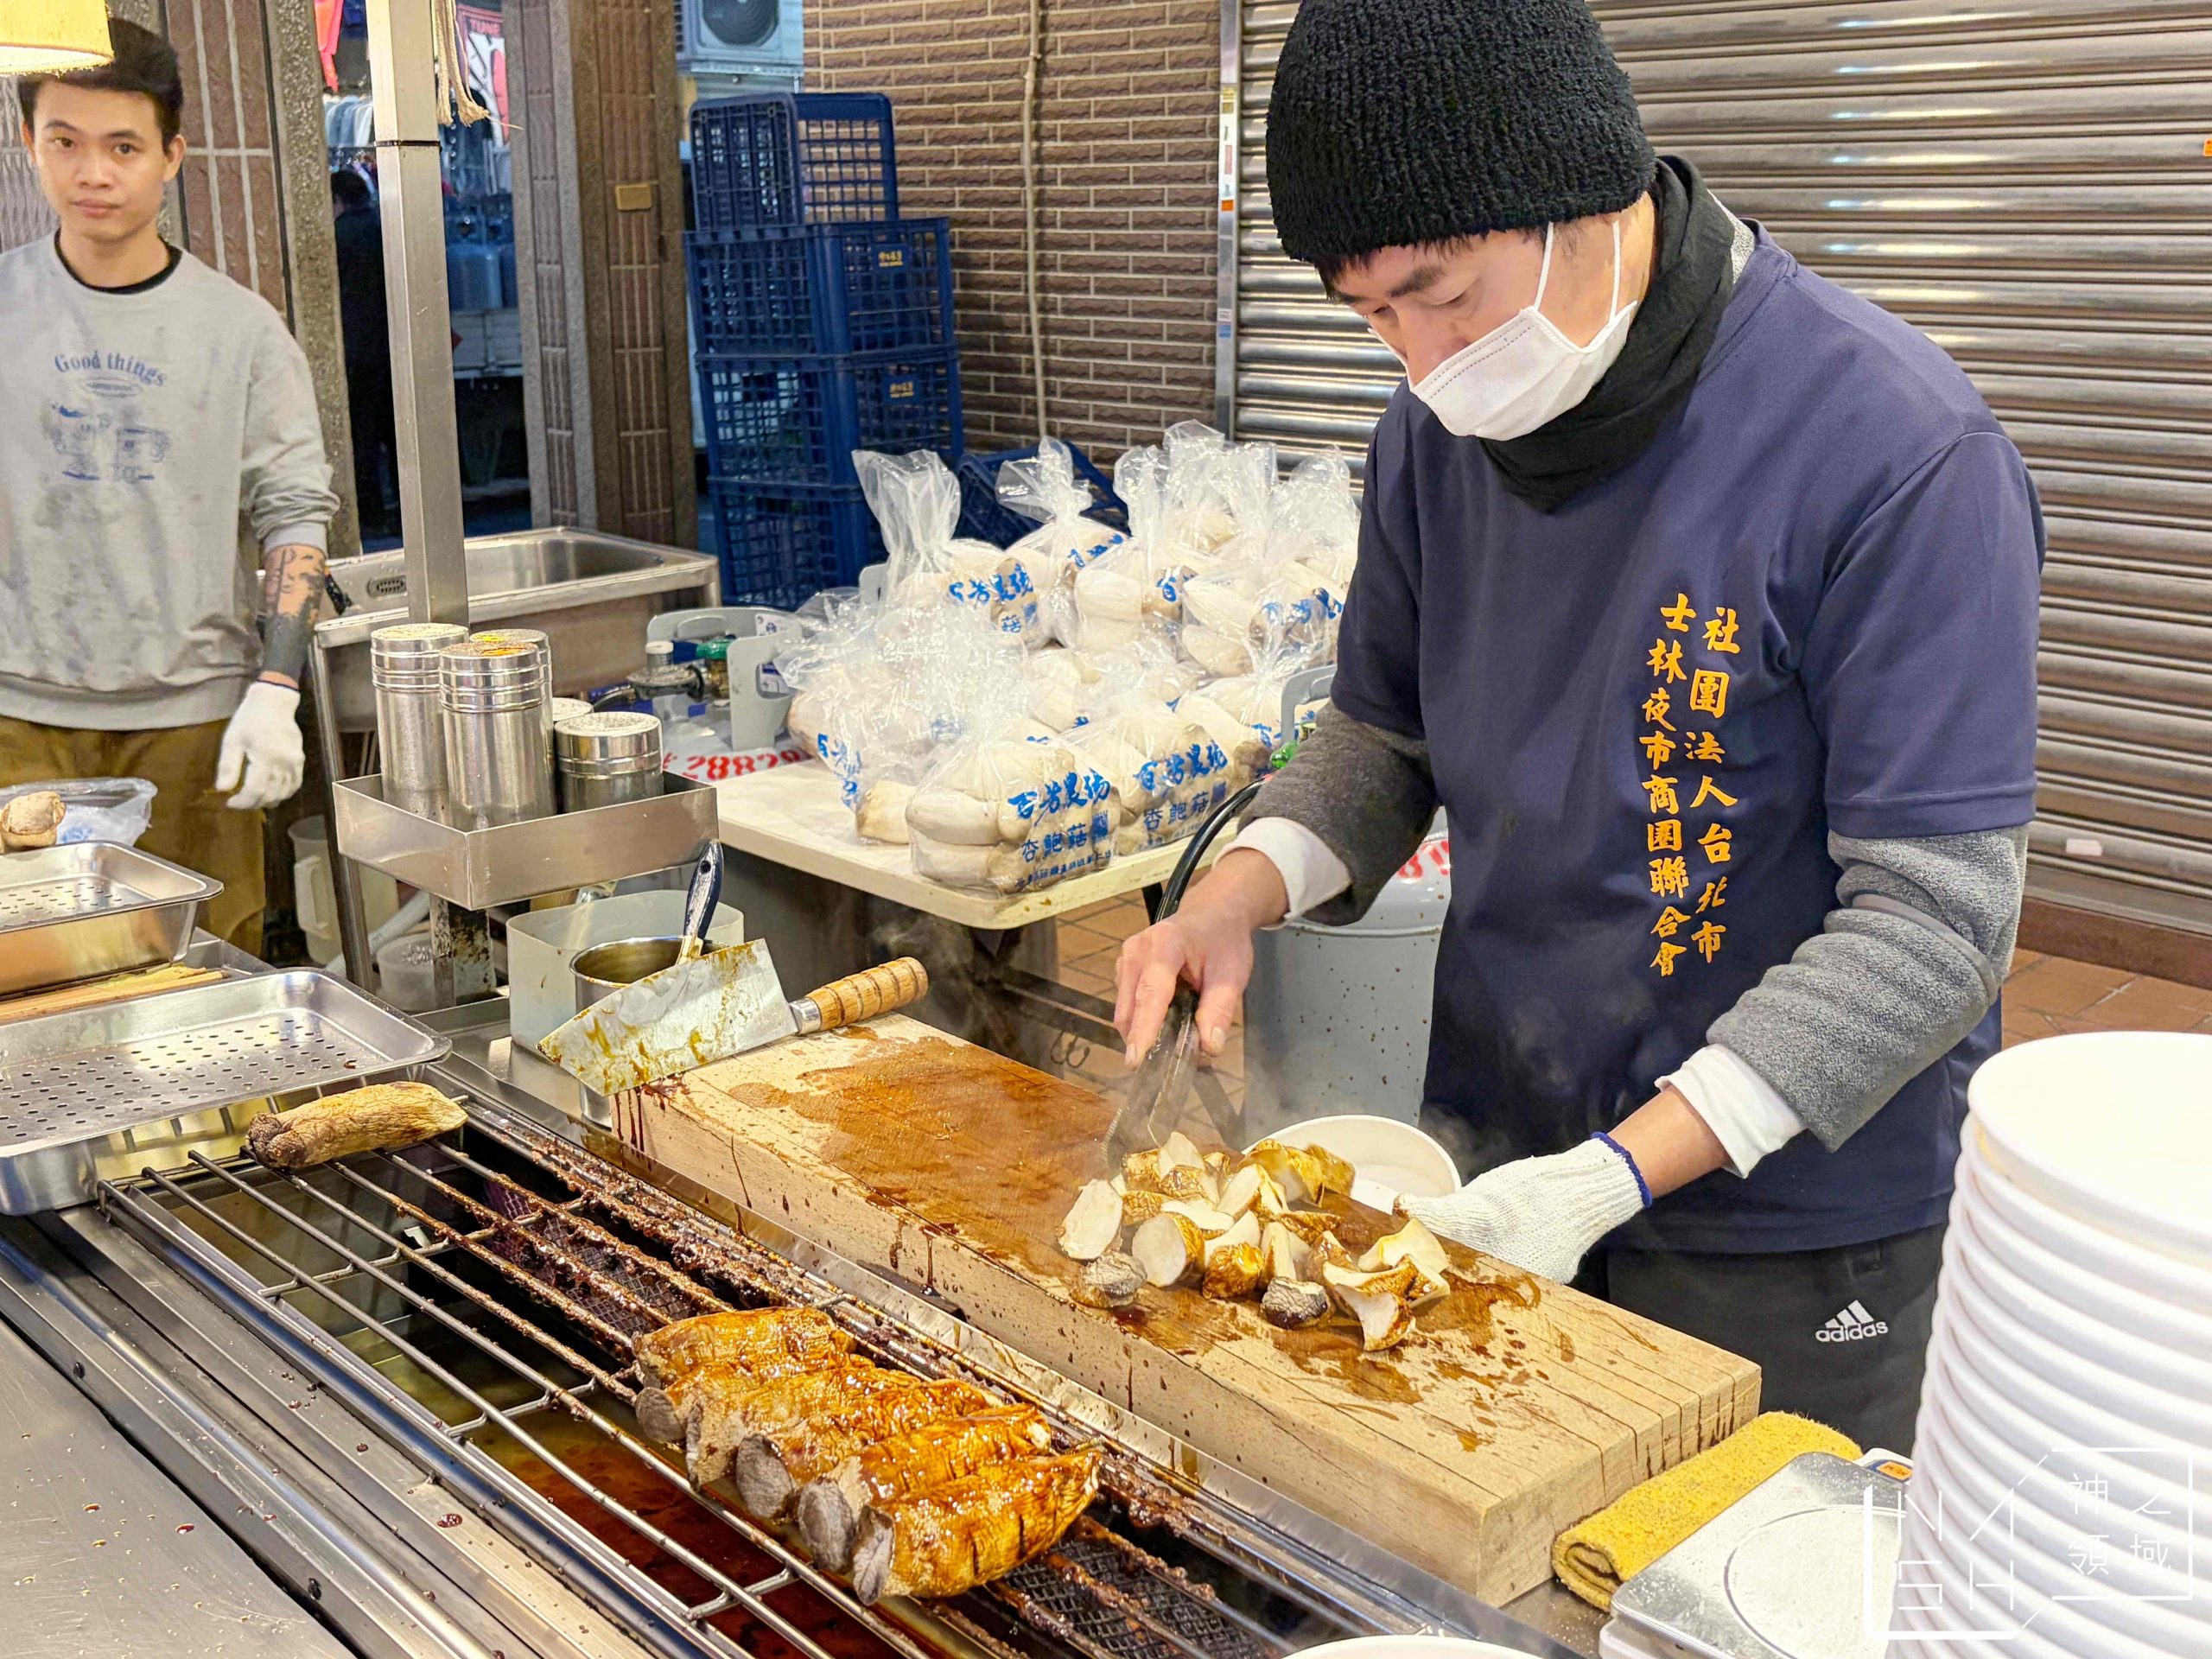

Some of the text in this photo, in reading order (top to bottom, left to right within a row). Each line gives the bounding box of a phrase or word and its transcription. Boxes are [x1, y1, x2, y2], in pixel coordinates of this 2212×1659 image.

[54, 350, 168, 386] Good things
[1639, 593, 1697, 976] 士林夜市商圈聯合會
[1685, 607, 1741, 963] 社團法人台北市
[1144, 791, 1211, 832] 杏鮑菇
[1021, 823, 1088, 862] 杏鮑菇
[1815, 1319, 1889, 1342] adidas
